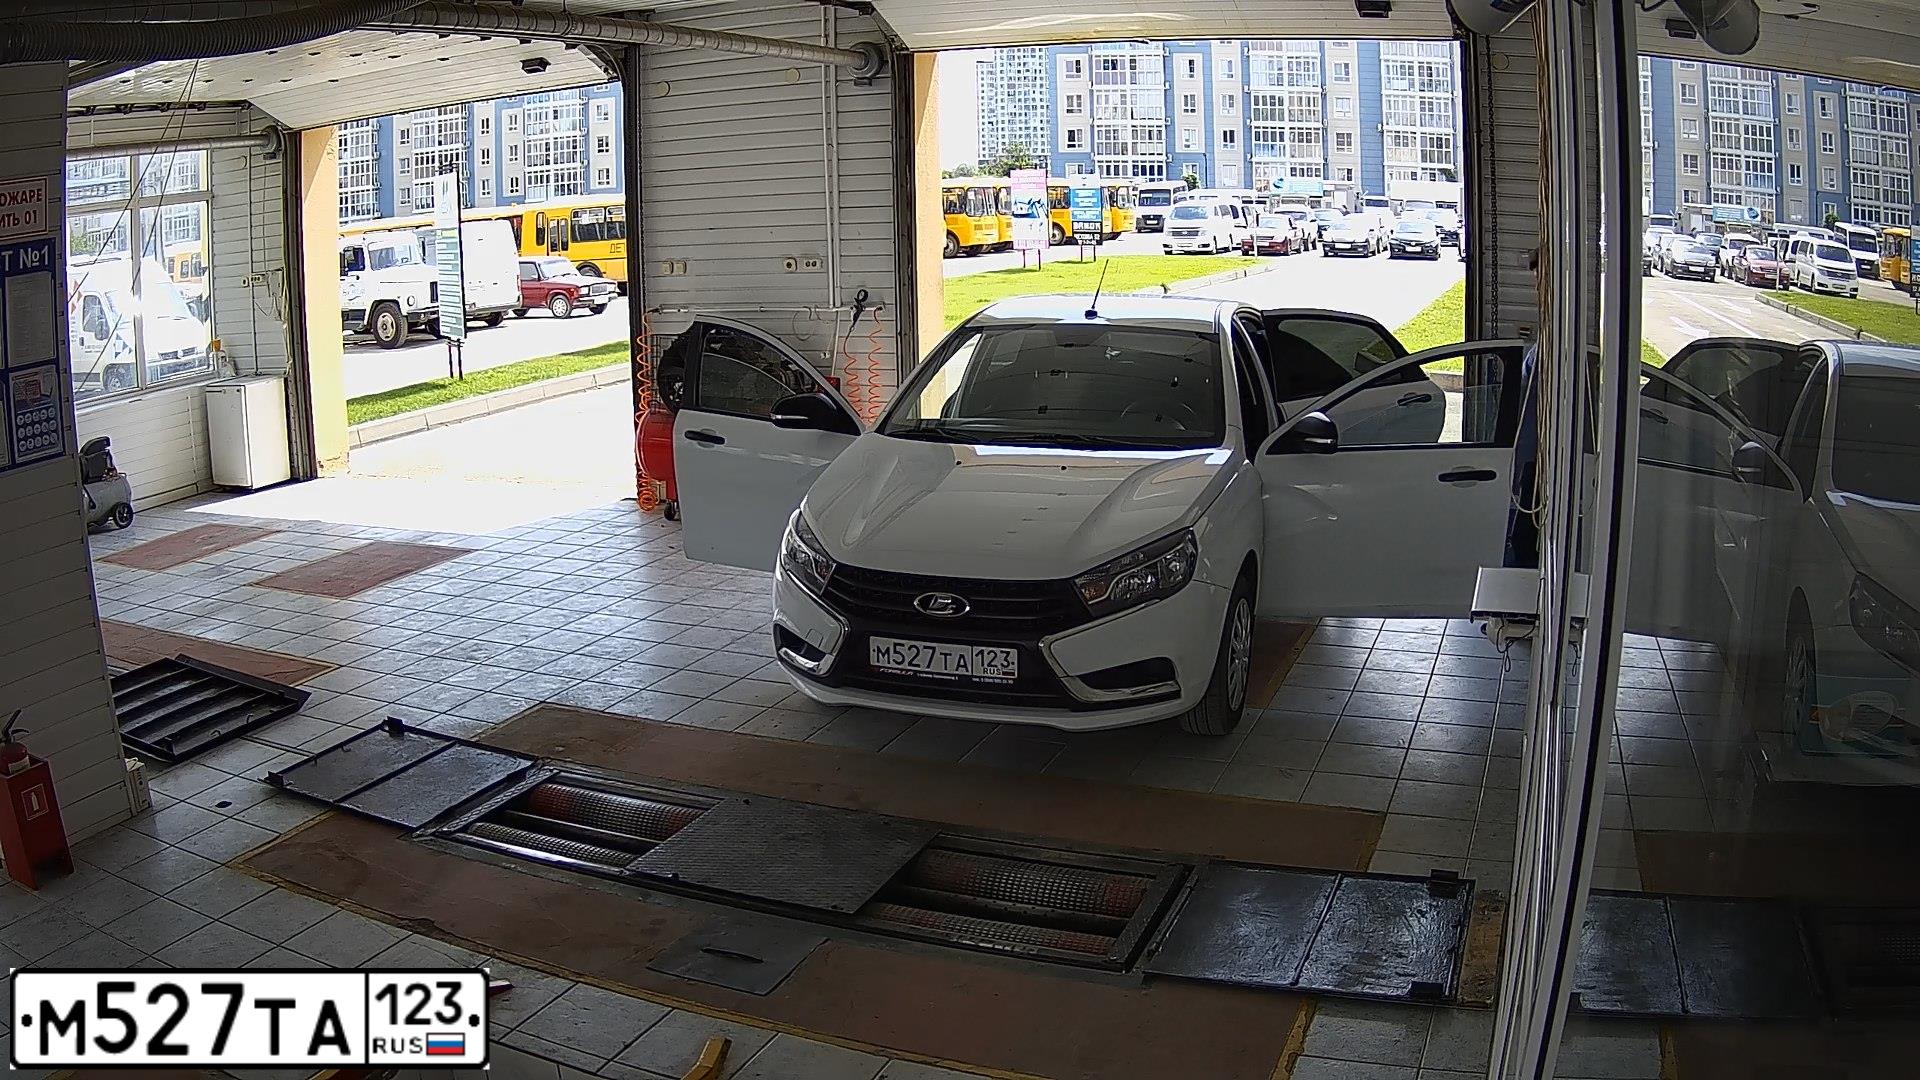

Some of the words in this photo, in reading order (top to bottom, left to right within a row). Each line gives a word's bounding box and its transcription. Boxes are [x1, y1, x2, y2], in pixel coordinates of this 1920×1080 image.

[24, 209, 37, 225] 01
[19, 245, 49, 269] №1
[876, 642, 970, 672] М527ТА
[974, 649, 1011, 668] 123
[983, 668, 1002, 676] RUS
